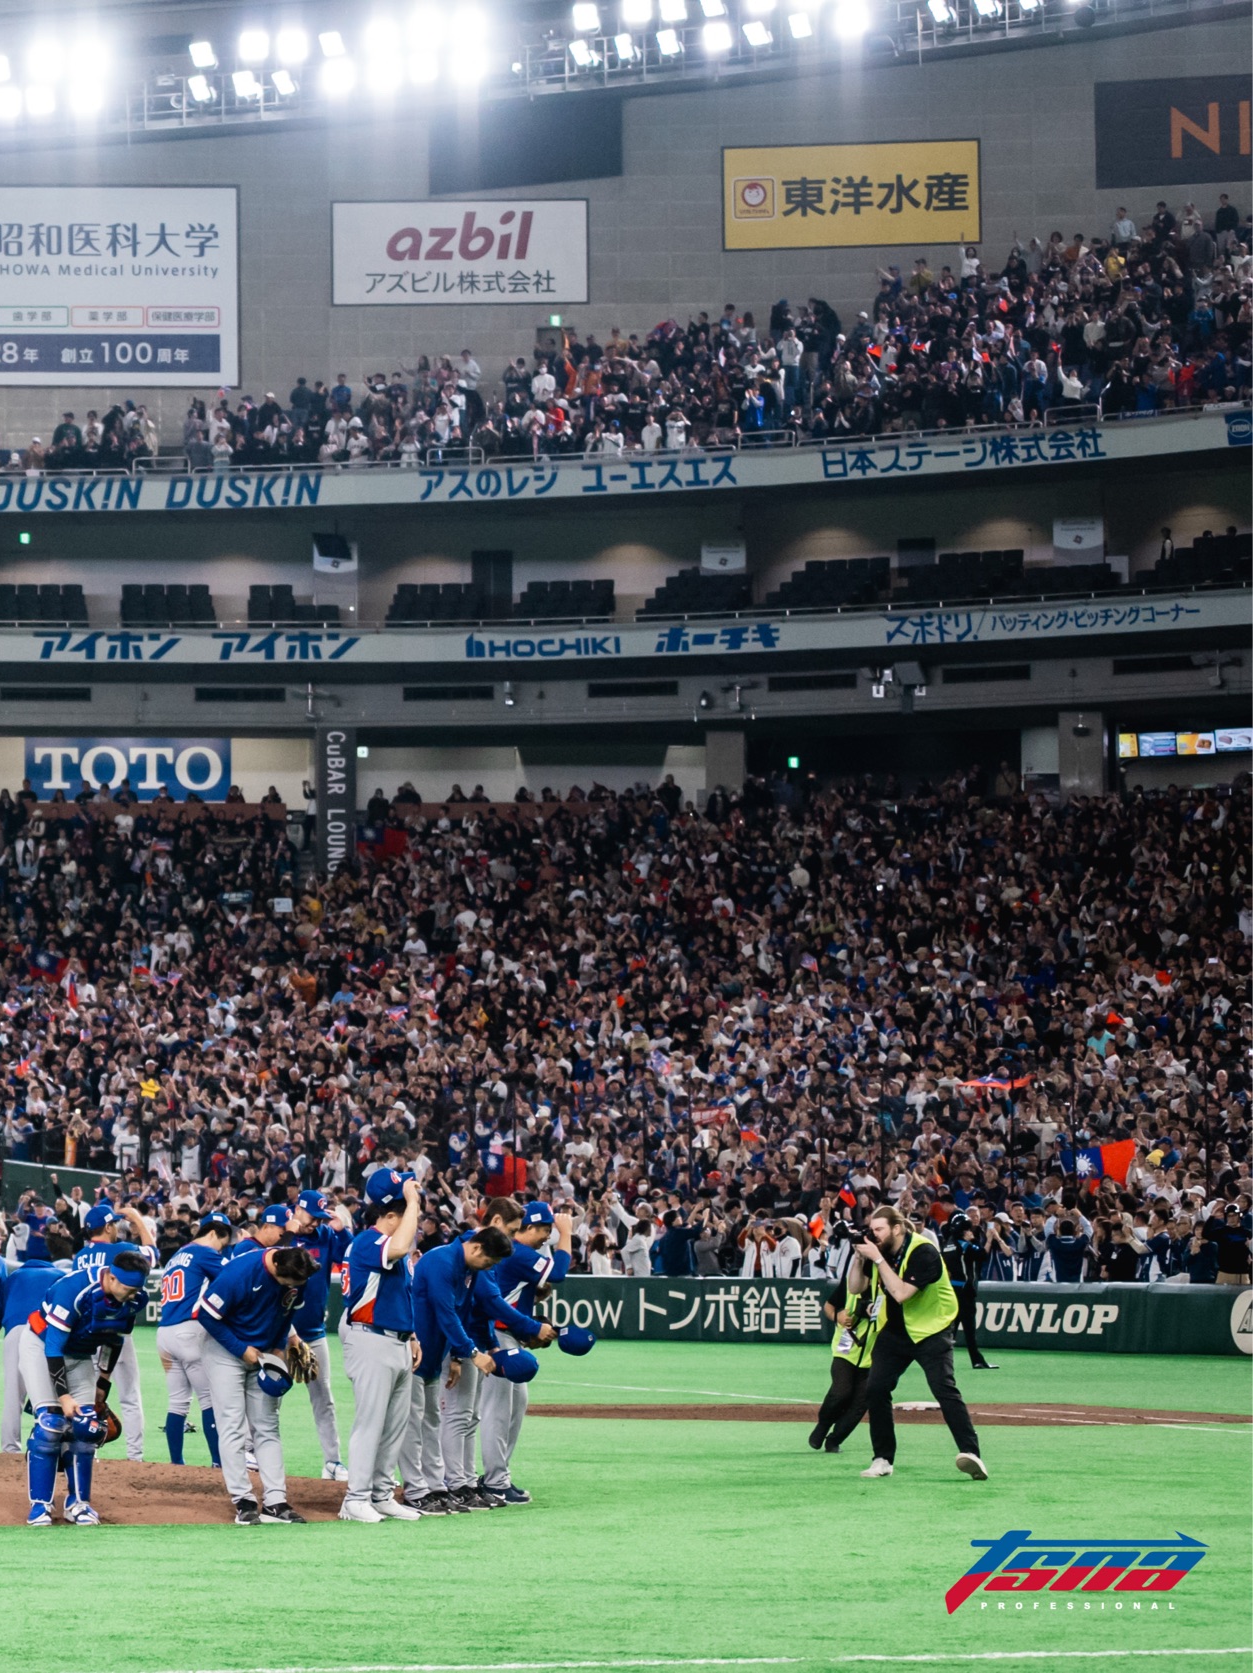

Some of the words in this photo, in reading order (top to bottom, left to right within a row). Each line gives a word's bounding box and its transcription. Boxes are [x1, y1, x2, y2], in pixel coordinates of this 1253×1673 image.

[781, 172, 970, 218] 東洋水産
[386, 210, 534, 262] azbil
[58, 264, 124, 277] Medical
[132, 264, 219, 279] University
[365, 270, 556, 294] アズビル株式会社
[821, 427, 1107, 479] 日本ステージ株式会社
[419, 467, 560, 500] アスのレジ
[581, 456, 737, 493] ユーエスエス
[33, 631, 182, 660] アイホン
[211, 632, 361, 661] アイホン
[489, 635, 621, 658] HOCHIKI
[655, 623, 780, 653] ホーチキ
[34, 746, 223, 791] TOTO
[326, 809, 346, 881] LOUNG
[639, 1285, 823, 1335] トンボ鉛筆
